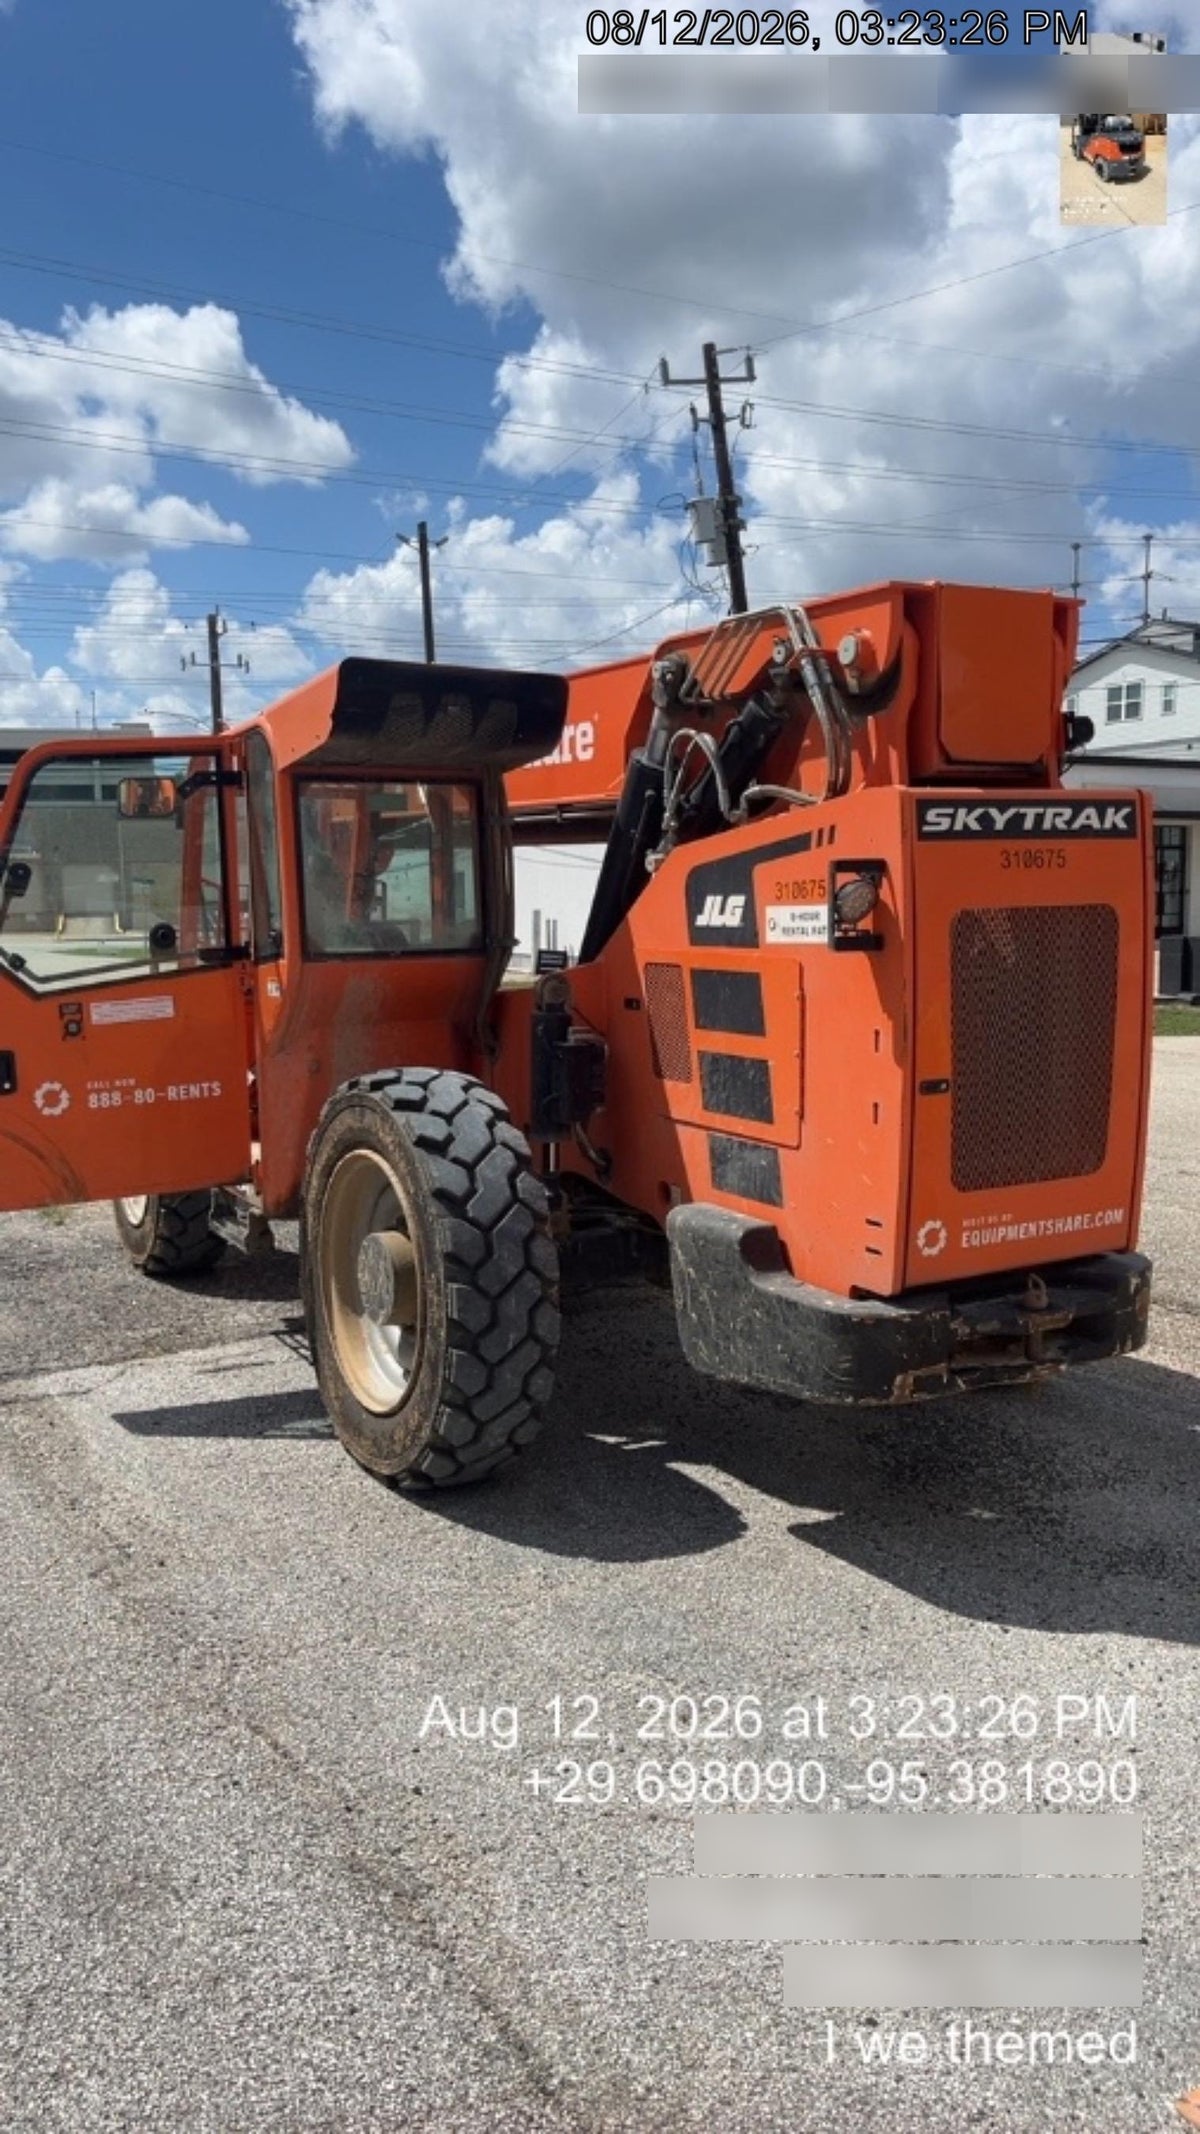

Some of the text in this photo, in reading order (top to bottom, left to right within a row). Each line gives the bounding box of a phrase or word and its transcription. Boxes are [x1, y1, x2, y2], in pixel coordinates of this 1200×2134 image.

[921, 805, 1132, 832] SKYTRAK
[1000, 849, 1067, 869] 310675
[775, 879, 826, 901] 310675
[694, 893, 746, 928] JLG
[811, 925, 828, 937] RAT
[88, 1081, 222, 1109] 888-80-RENTS
[961, 1208, 1124, 1248] EQUIPMENTSHARE.COM
